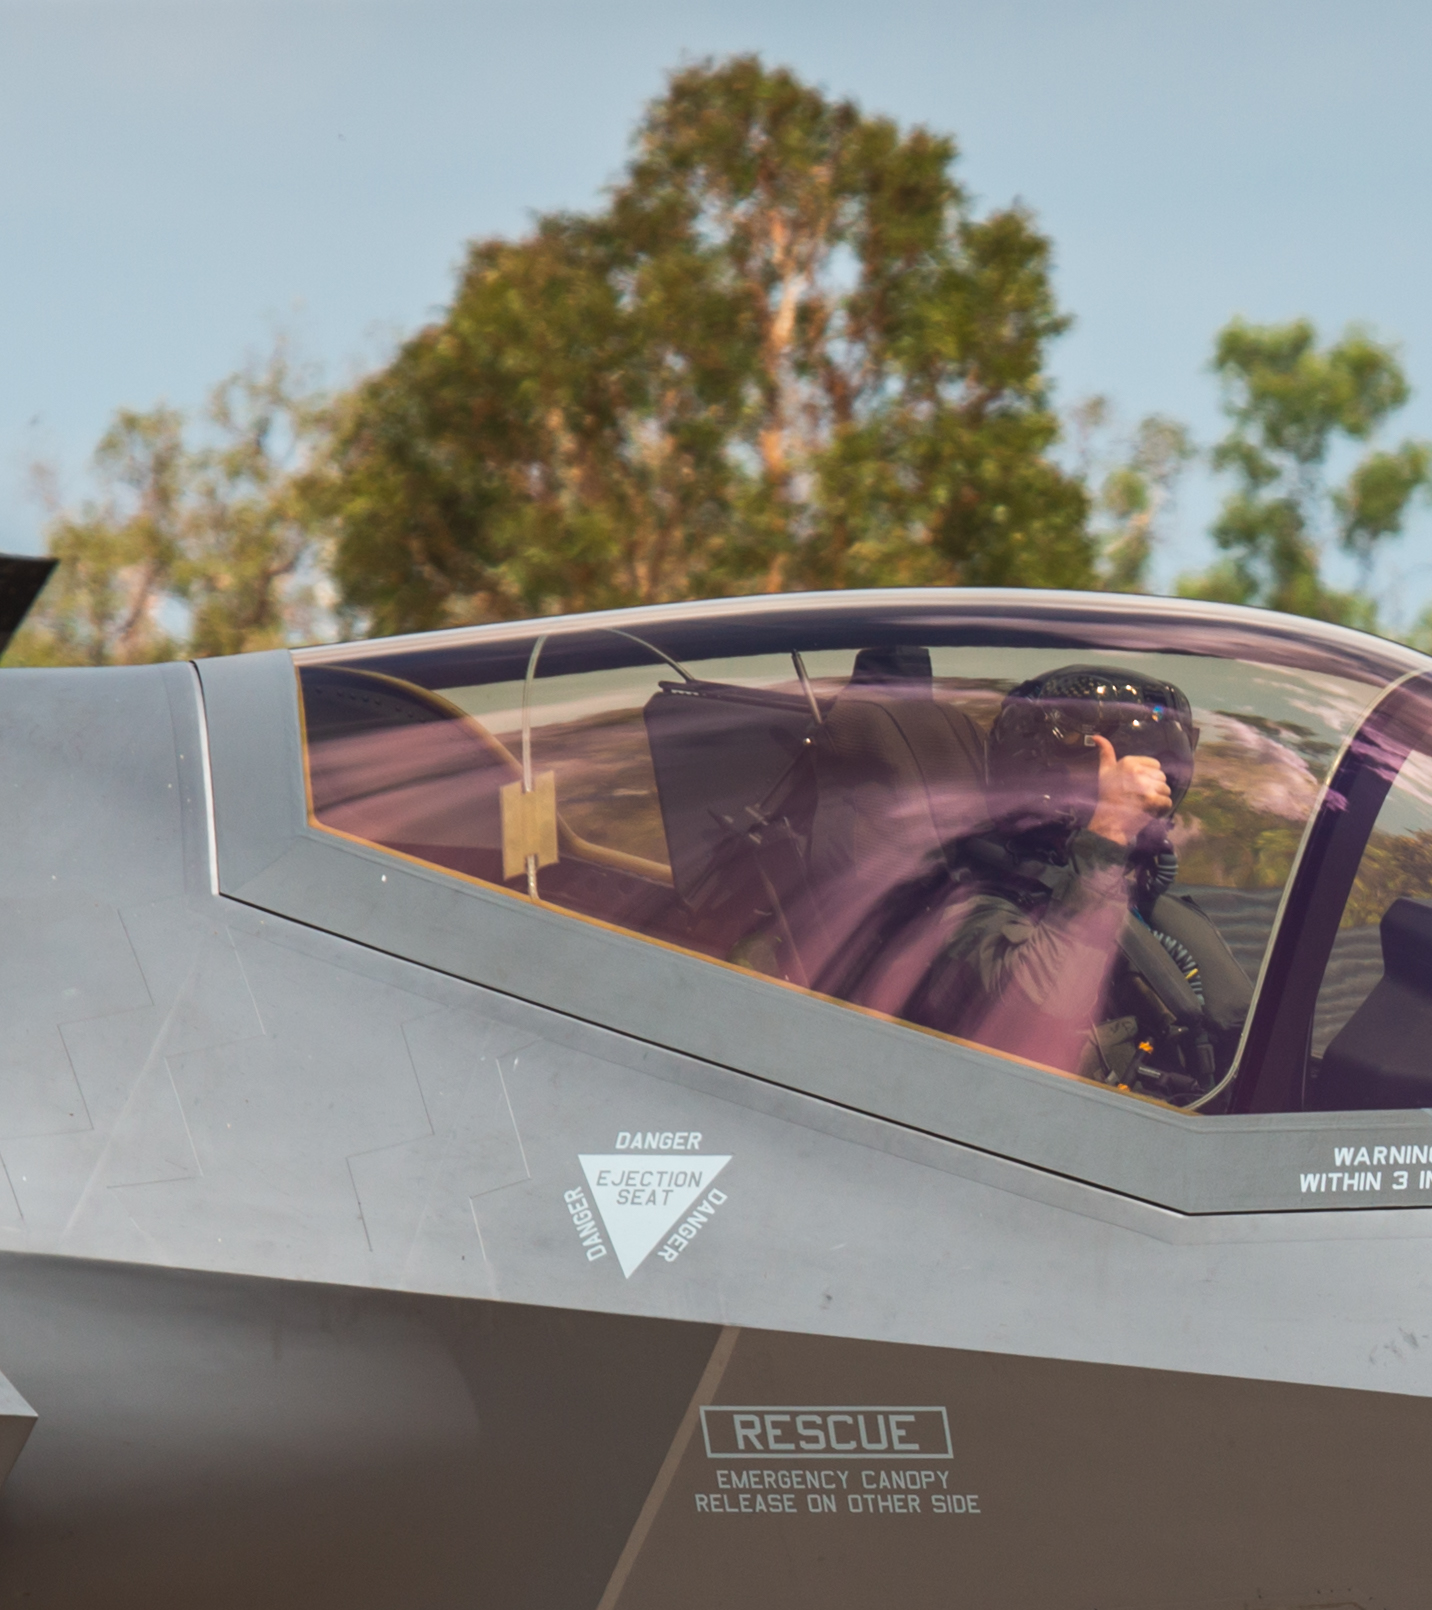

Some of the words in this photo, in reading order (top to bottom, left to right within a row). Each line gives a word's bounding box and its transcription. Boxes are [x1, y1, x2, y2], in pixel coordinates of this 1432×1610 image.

[615, 1131, 703, 1150] DANGER
[595, 1169, 705, 1189] EJECTION
[1299, 1171, 1382, 1193] WITHIN
[1392, 1170, 1409, 1190] 3
[616, 1188, 674, 1206] SEAT
[563, 1185, 605, 1262] DANGER
[657, 1187, 728, 1263] DANGER
[733, 1414, 920, 1451] RESCUE
[716, 1469, 849, 1489] EMERGENCY
[861, 1470, 949, 1490] CANOPY
[694, 1493, 798, 1513] RELEASE
[806, 1493, 837, 1513] ON
[847, 1494, 921, 1513] OTHER
[931, 1494, 981, 1514] SIDE
